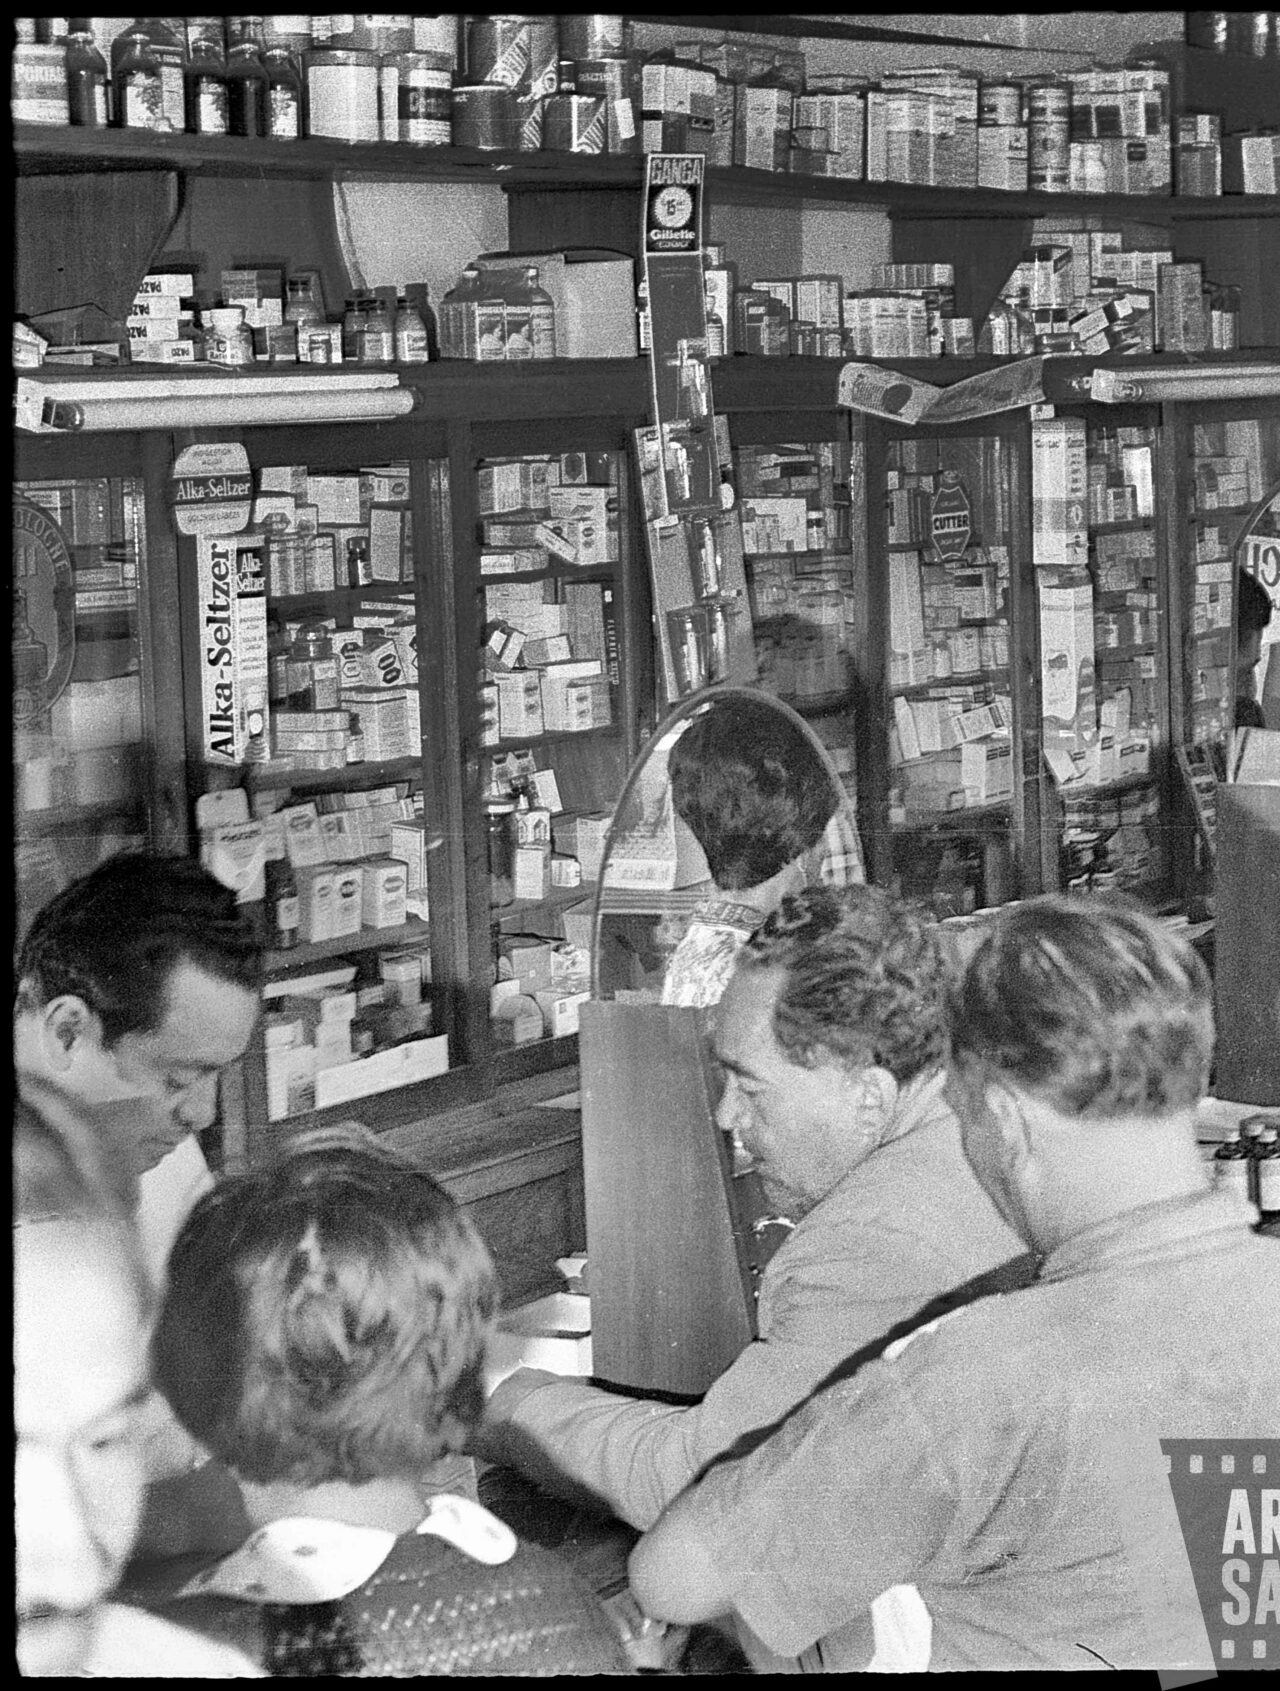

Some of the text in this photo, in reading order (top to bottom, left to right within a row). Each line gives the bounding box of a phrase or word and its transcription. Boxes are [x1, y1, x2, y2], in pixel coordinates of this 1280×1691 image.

[651, 158, 701, 184] GANGA
[650, 228, 696, 240] Gillette
[176, 477, 251, 500] Alka-Seltzer
[933, 514, 969, 532] CUTTER
[206, 542, 235, 759] Alka-Seltzer
